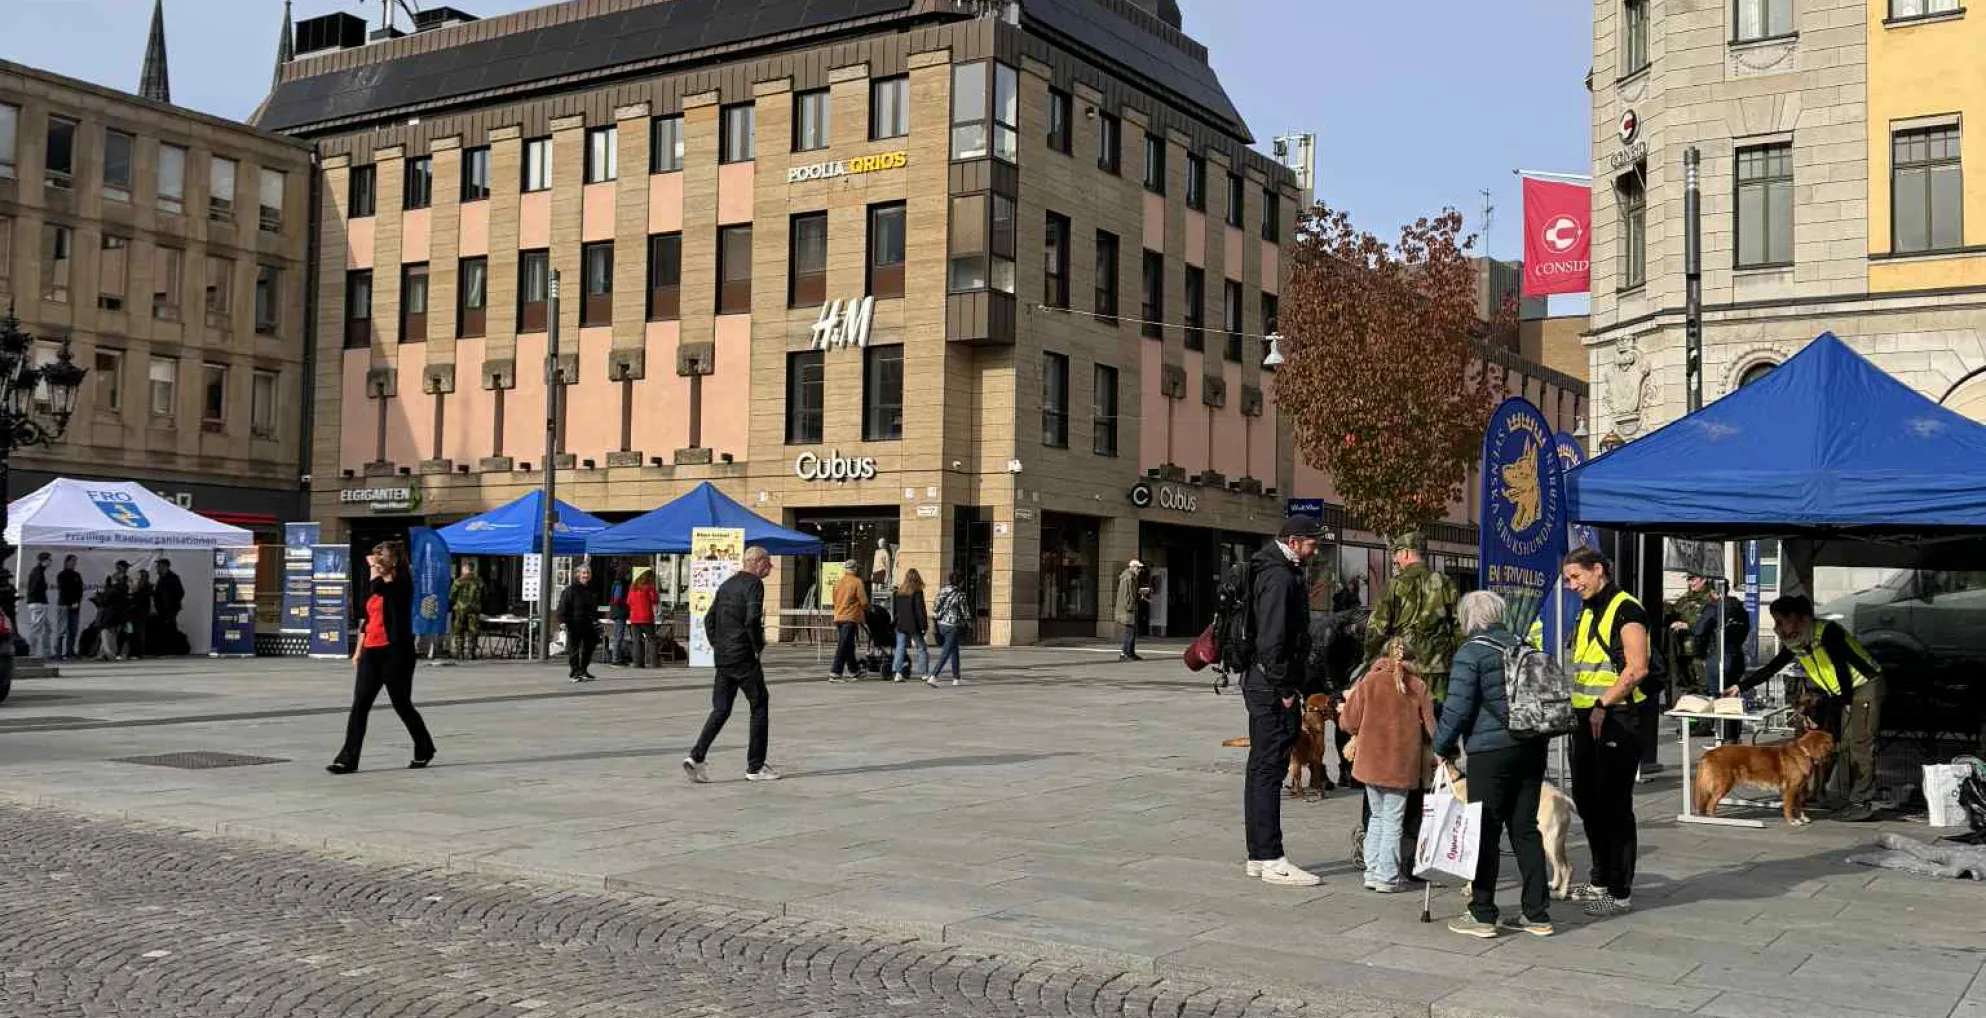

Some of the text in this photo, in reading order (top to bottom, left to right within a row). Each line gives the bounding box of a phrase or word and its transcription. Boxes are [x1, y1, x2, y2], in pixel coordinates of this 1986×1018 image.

[788, 151, 907, 183] POOLIA QRIOS
[1611, 141, 1648, 169] CONSID
[1536, 260, 1590, 276] CONSID
[812, 296, 875, 351] H&M
[796, 449, 877, 482] Cubus
[86, 490, 132, 502] FRO
[341, 488, 410, 501] ELGIGANTEN
[1160, 486, 1197, 512] Cubus
[65, 532, 217, 546] Frivilliga Radioorganisationen
